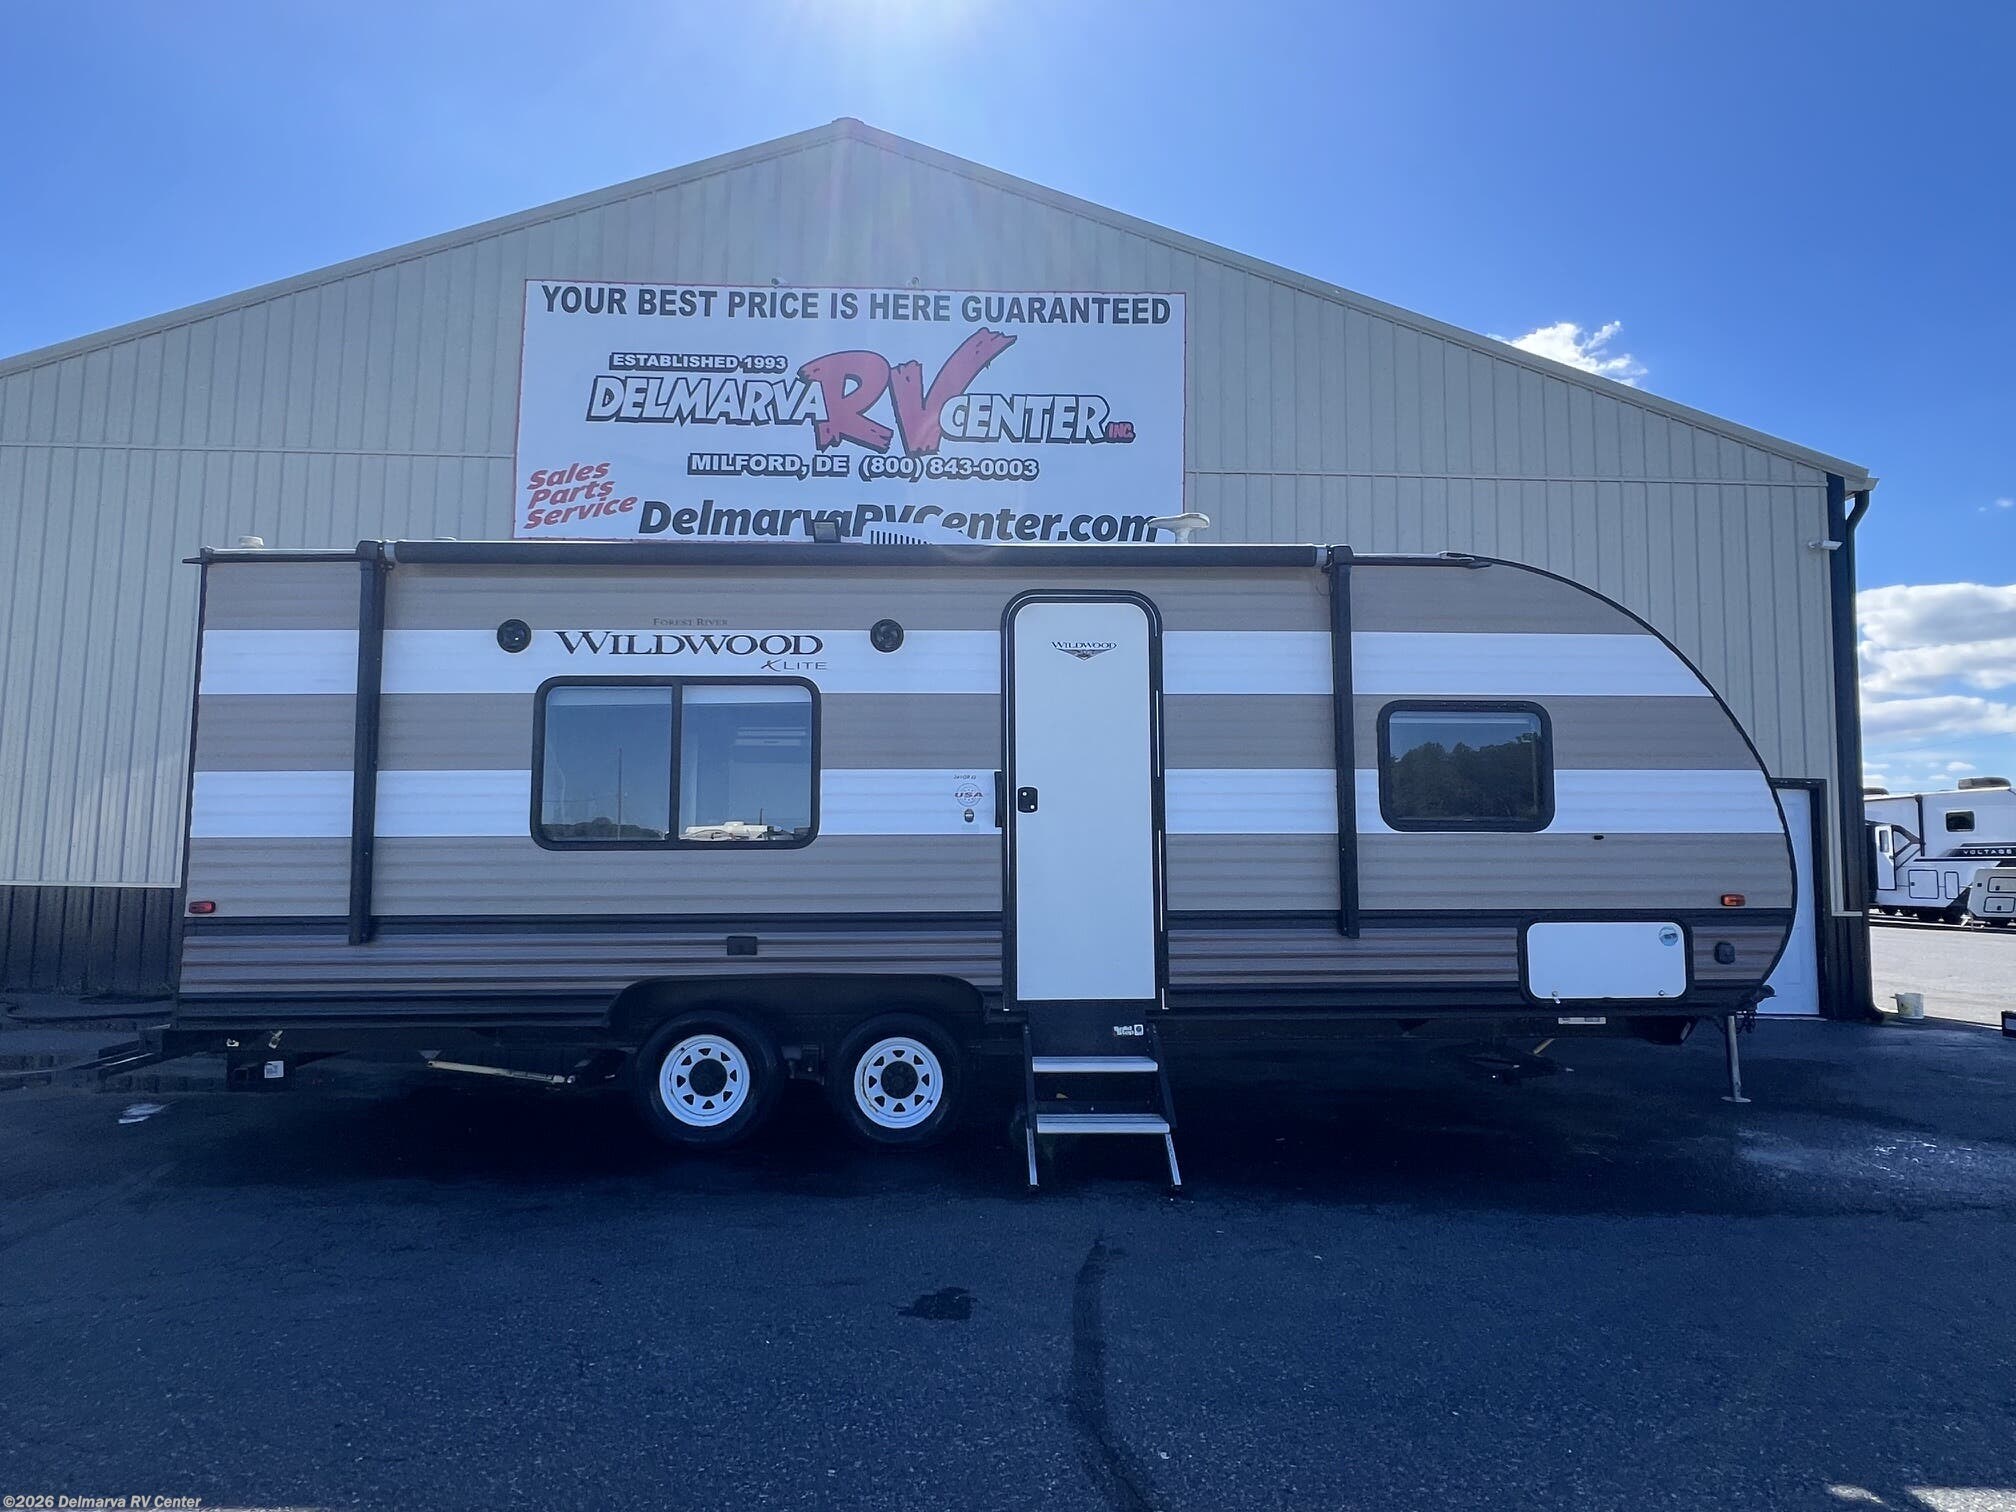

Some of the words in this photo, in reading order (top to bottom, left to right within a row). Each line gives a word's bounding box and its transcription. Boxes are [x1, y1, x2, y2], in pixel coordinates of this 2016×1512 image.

[541, 285, 627, 315] YOUR
[638, 289, 718, 318] BEST
[728, 291, 819, 319] PRICE
[830, 292, 859, 320] IS
[869, 294, 951, 322] HERE
[961, 296, 1171, 325] GUARANTEED
[609, 352, 740, 371] ESTABLISHED
[742, 355, 788, 373] 1993
[586, 374, 830, 427] DELMARVA
[797, 327, 1018, 458] RV
[938, 393, 1111, 445] CENTER
[526, 462, 612, 491] Sales
[688, 452, 810, 481] MILFORD,
[812, 454, 851, 478] DE
[859, 455, 924, 483] (800)
[926, 457, 1040, 481] 843-0003
[527, 480, 617, 510] Parts
[522, 496, 639, 530] Service
[554, 630, 824, 656] WILDWOOD
[1050, 641, 1118, 649] WILDWOOD
[954, 791, 984, 799] USA
